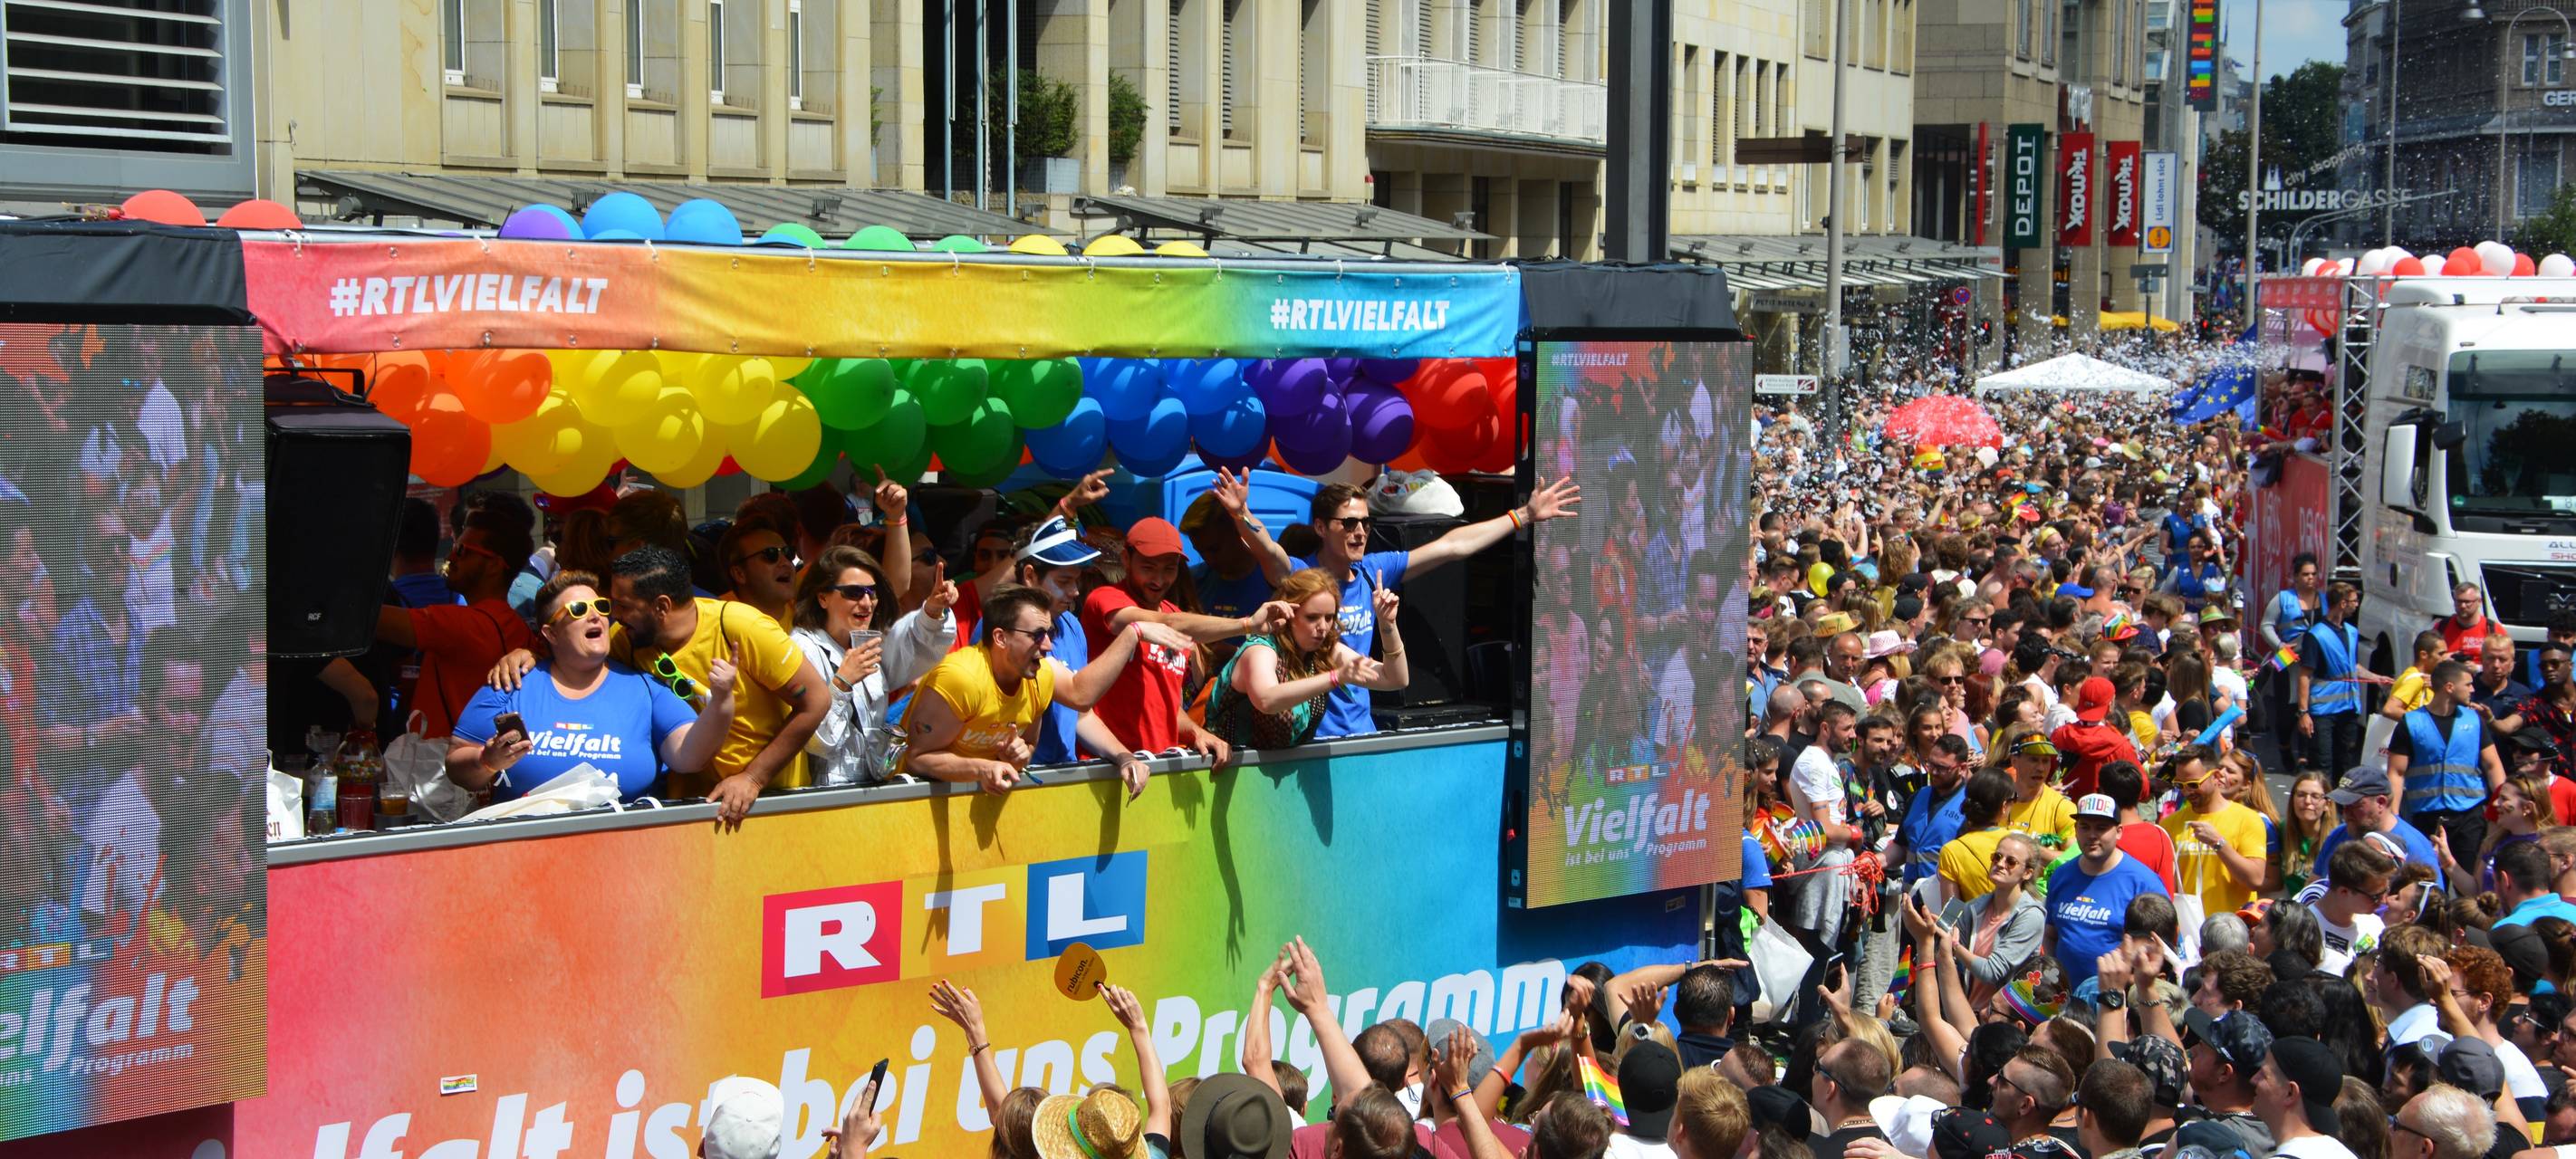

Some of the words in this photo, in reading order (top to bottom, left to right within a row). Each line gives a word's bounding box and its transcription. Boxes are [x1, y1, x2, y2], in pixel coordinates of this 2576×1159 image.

[2158, 158, 2166, 176] sich
[2284, 169, 2307, 187] city
[2310, 142, 2367, 177] shopping
[2014, 136, 2035, 237] DEPOT
[2157, 179, 2165, 202] lohnt
[2156, 205, 2164, 221] Lidl
[330, 274, 609, 317] #RTLVIELFALT
[1270, 299, 1449, 331] #RTLVIELFALT
[1551, 352, 1629, 367] #RTLVIELFALT
[528, 731, 622, 756] Vielfalt
[578, 752, 621, 760] Programm
[1610, 765, 1667, 781] RTL
[2079, 797, 2111, 814] PRIDE
[1564, 789, 1710, 852] Vielfalt
[1565, 852, 1581, 867] ist
[1586, 848, 1605, 865] bei
[1609, 848, 1629, 860] uns
[1646, 838, 1706, 857] Programm
[2058, 902, 2111, 921] Vielfalt
[783, 872, 1128, 979] RTL
[70, 1043, 194, 1076] Programm
[956, 1031, 1120, 1132] uns
